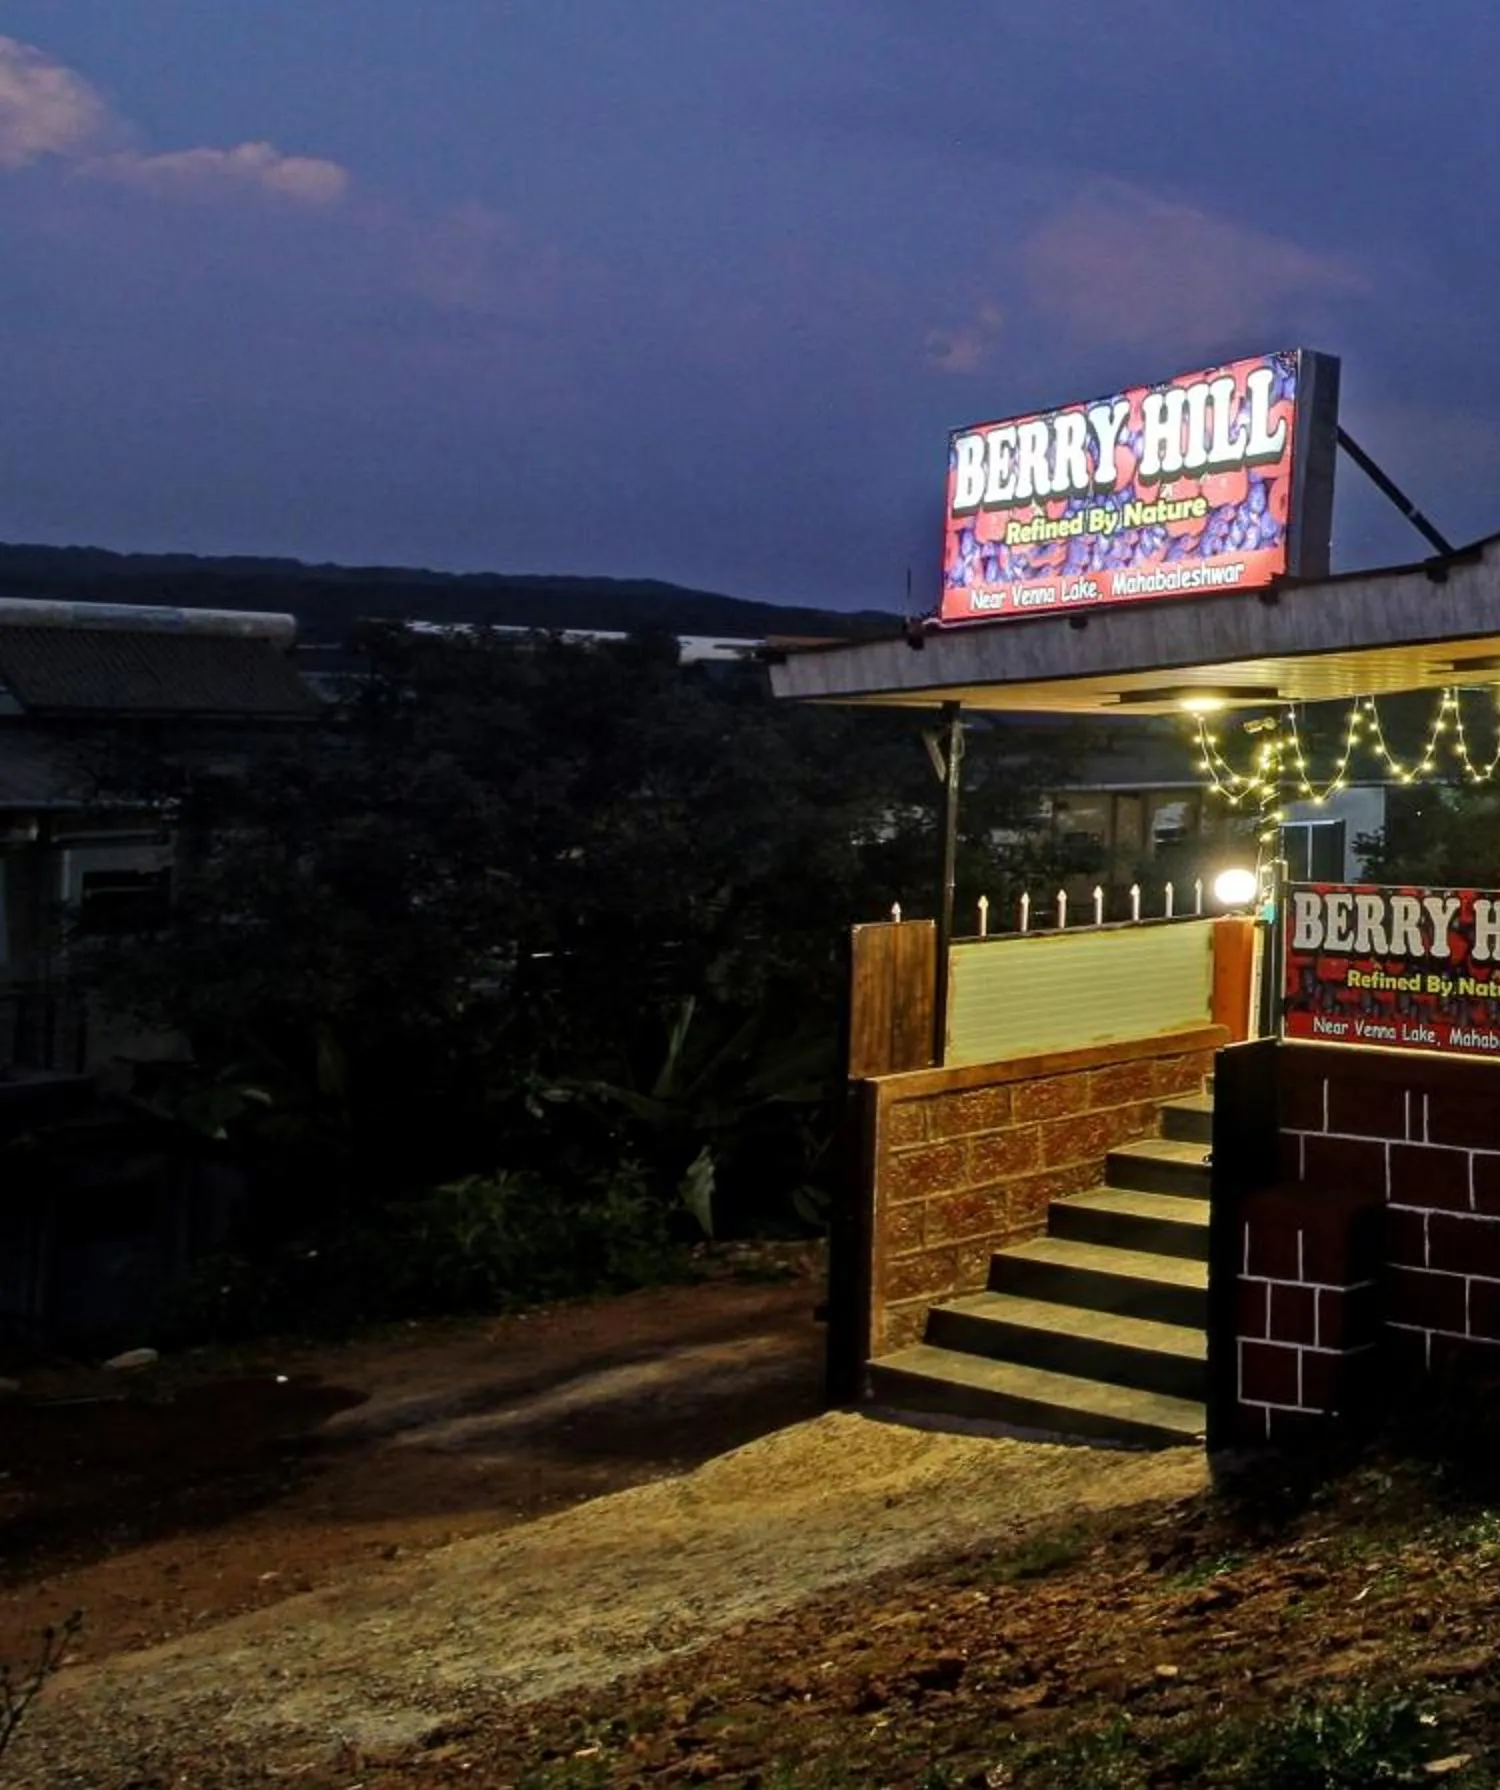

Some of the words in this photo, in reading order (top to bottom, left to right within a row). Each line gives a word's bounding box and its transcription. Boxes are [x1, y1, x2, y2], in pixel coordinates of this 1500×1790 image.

[953, 401, 1130, 510] BERRY
[1139, 369, 1286, 476] HILL
[1006, 513, 1083, 545] Refined
[1088, 508, 1119, 536] By
[1123, 495, 1208, 527] Nature
[972, 588, 1005, 611] Near
[1012, 582, 1056, 607] Venna
[1111, 561, 1245, 595] Mahabaleshwar
[1292, 892, 1460, 957] BERRY
[1347, 970, 1421, 993] Refined
[1427, 975, 1453, 996] By
[1313, 1016, 1349, 1036] Near
[1354, 1019, 1397, 1041] Venna
